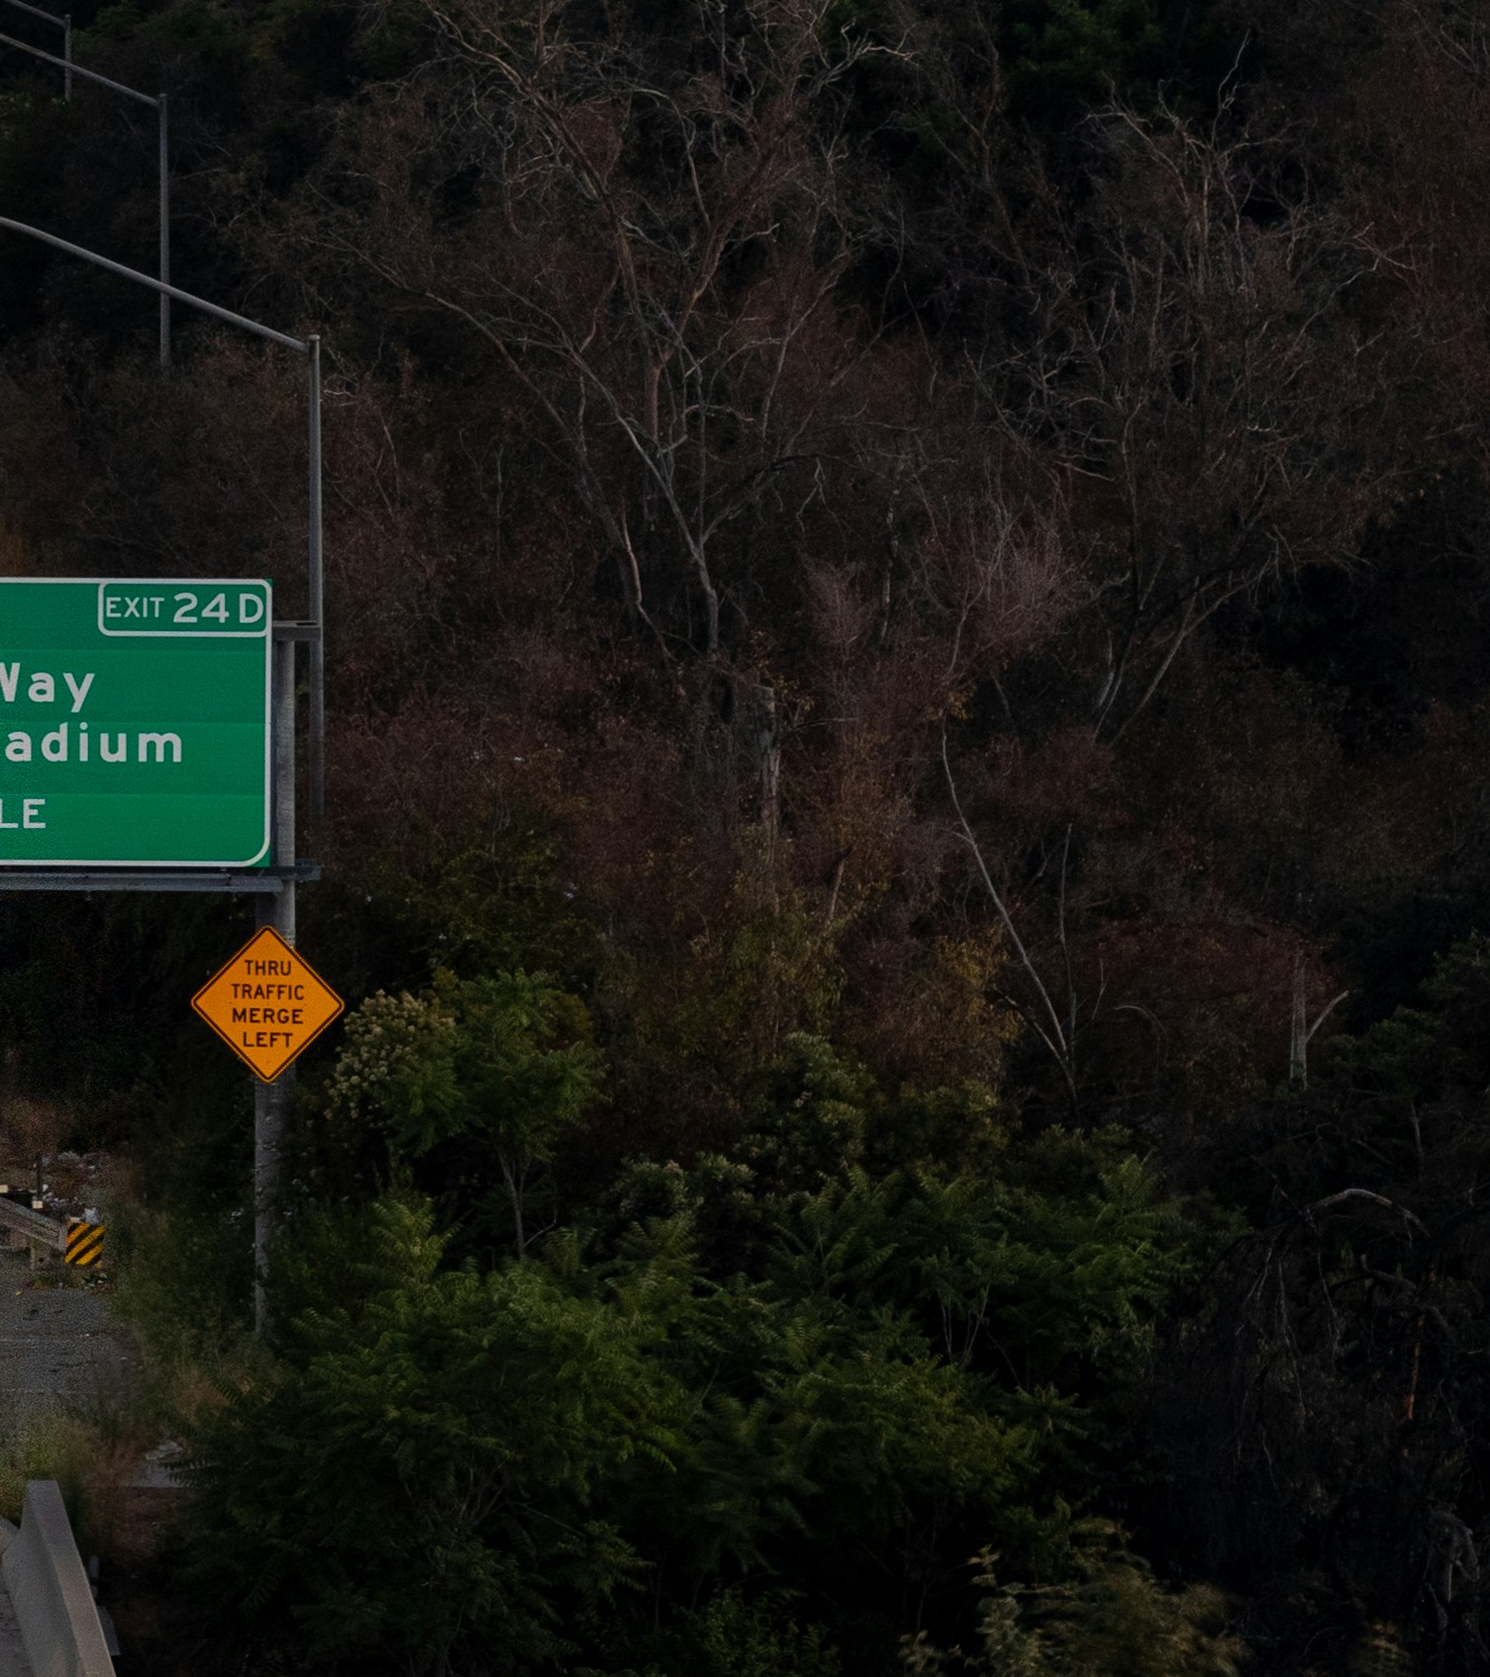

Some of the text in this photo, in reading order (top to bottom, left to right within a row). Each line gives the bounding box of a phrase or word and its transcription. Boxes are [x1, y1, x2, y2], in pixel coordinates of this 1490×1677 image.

[106, 596, 165, 618] EXIT
[244, 960, 291, 975] THRU
[231, 984, 304, 1000] TRAFFIC
[232, 1008, 303, 1024] MERGE
[243, 1032, 293, 1048] LEFT
